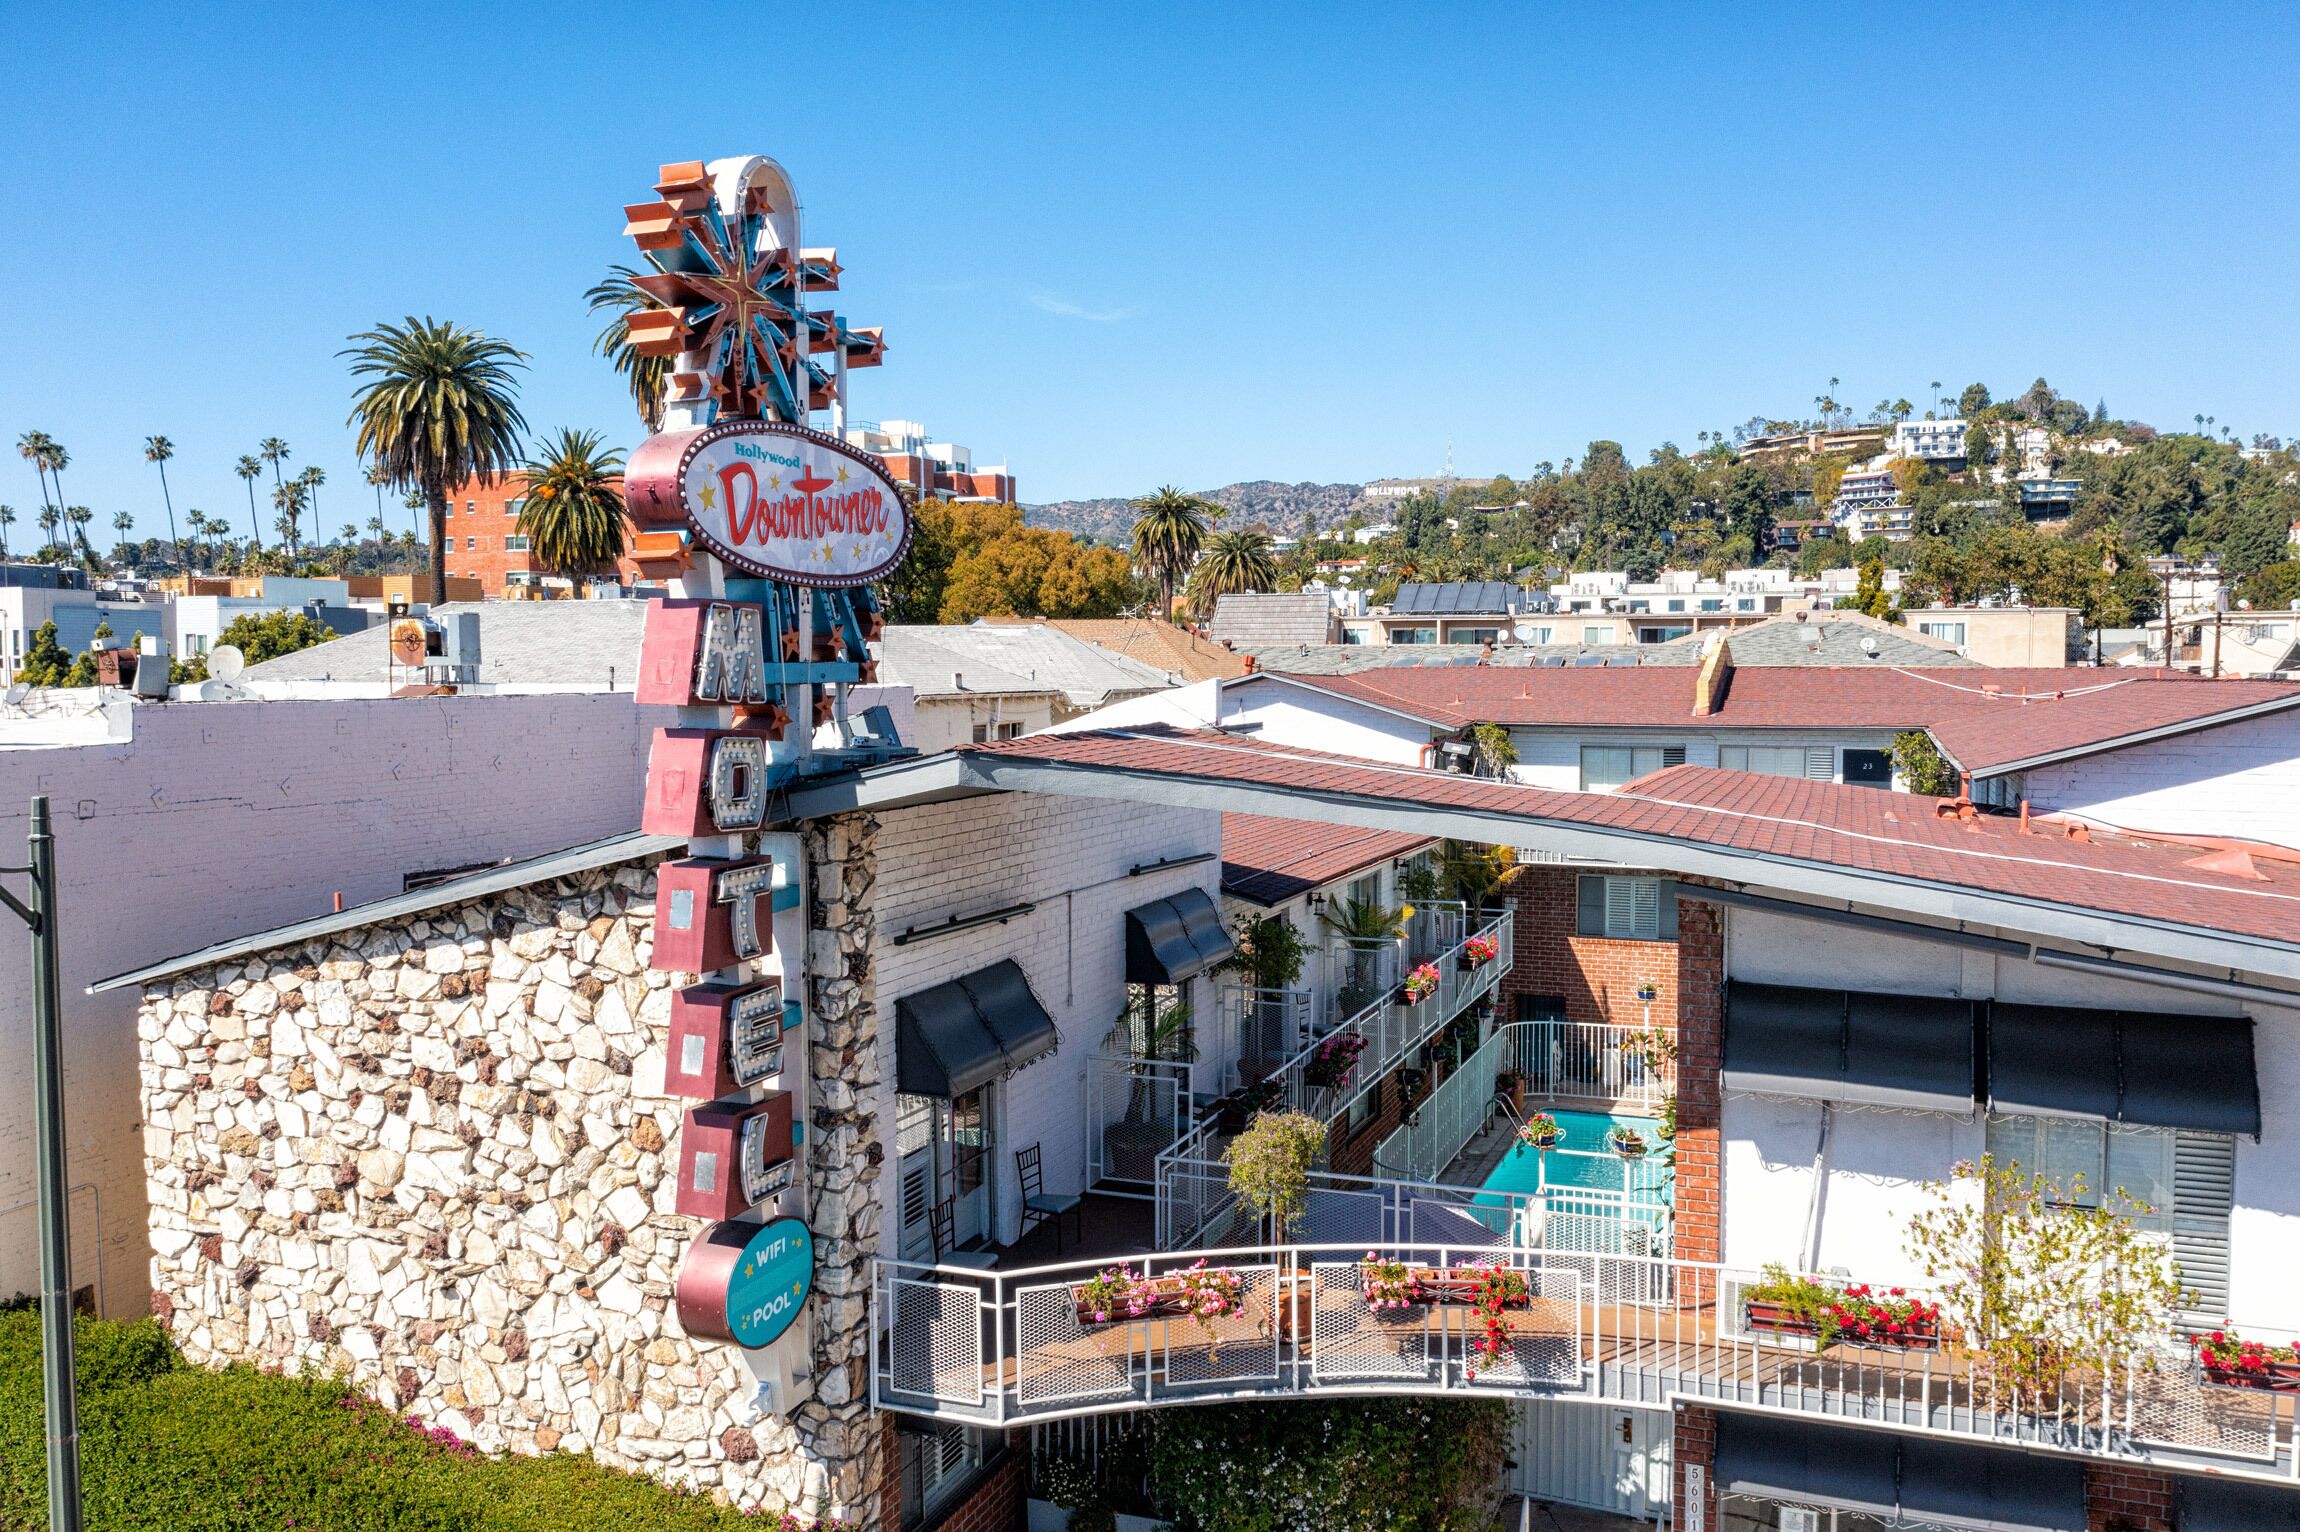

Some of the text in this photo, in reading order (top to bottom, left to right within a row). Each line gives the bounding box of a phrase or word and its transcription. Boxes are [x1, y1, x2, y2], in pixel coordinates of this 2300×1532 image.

[734, 441, 800, 469] Hollywood
[1365, 486, 1420, 496] HOLLYWOOD
[1862, 762, 1873, 770] 23
[697, 602, 796, 1208] MOTEL
[755, 1236, 786, 1268] WIFI
[752, 1291, 792, 1328] POOL
[1690, 1468, 1699, 1531] 5601
